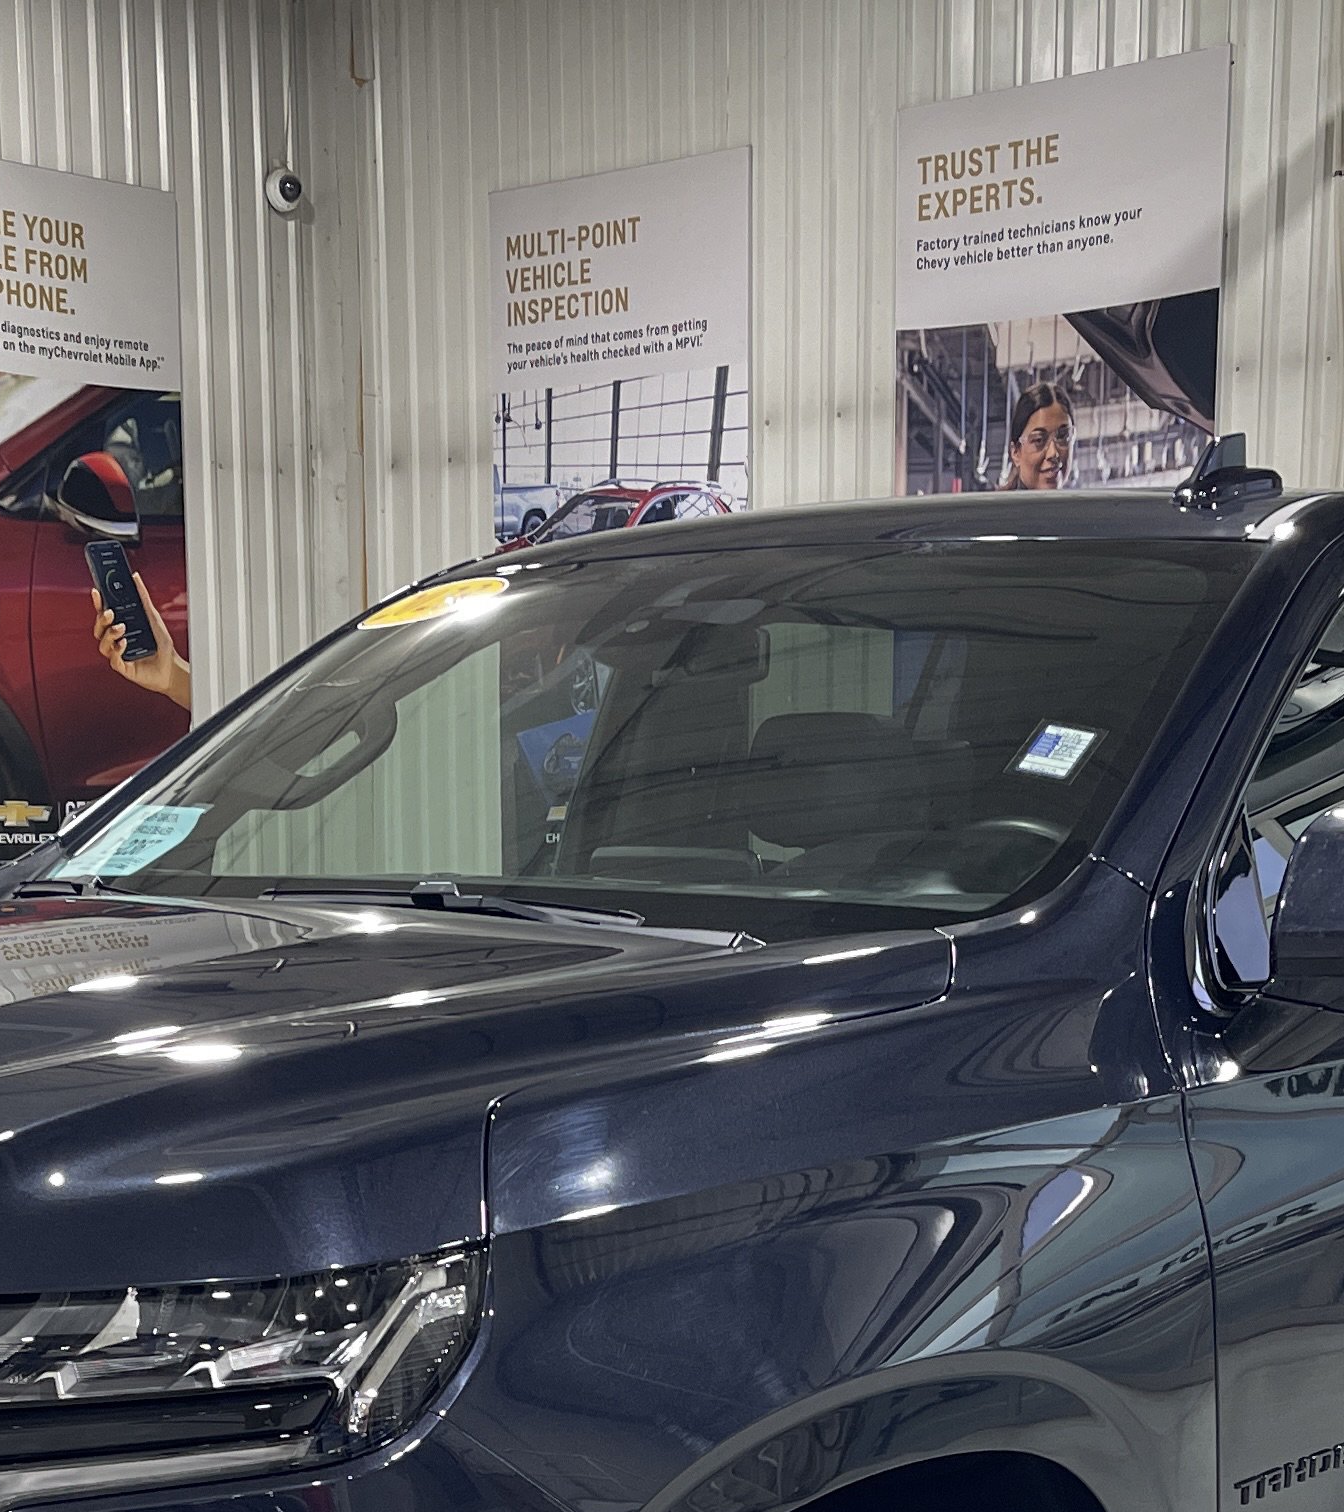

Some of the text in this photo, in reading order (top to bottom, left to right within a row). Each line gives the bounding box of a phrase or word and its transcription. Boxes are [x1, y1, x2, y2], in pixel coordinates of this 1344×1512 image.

[917, 133, 1060, 186] TRUST THE
[917, 176, 1044, 222] EXPERTS.
[23, 213, 85, 250] YOUR
[506, 216, 641, 262] MULTI-POINT
[916, 207, 1143, 253] Factory trained technicians know your
[24, 248, 88, 284] FROM
[916, 232, 1115, 271] Chevy vehicle better than anyone.
[506, 258, 592, 294] VEHICLE
[507, 286, 629, 327] INSPECTION
[1, 320, 61, 341] diagnostics
[63, 332, 82, 344] and
[84, 334, 111, 350] enjoy
[113, 339, 149, 352] remote
[3, 340, 16, 351] on
[19, 341, 35, 354] the
[38, 345, 103, 363] myChevrolet
[105, 352, 137, 367] Mobile
[507, 318, 708, 355] The peace of mind that comes from getting
[507, 359, 528, 374] your
[529, 353, 568, 368] vehicle's
[570, 349, 600, 364] health
[601, 343, 641, 360] checked
[643, 341, 665, 354] with
[667, 341, 673, 351] a
